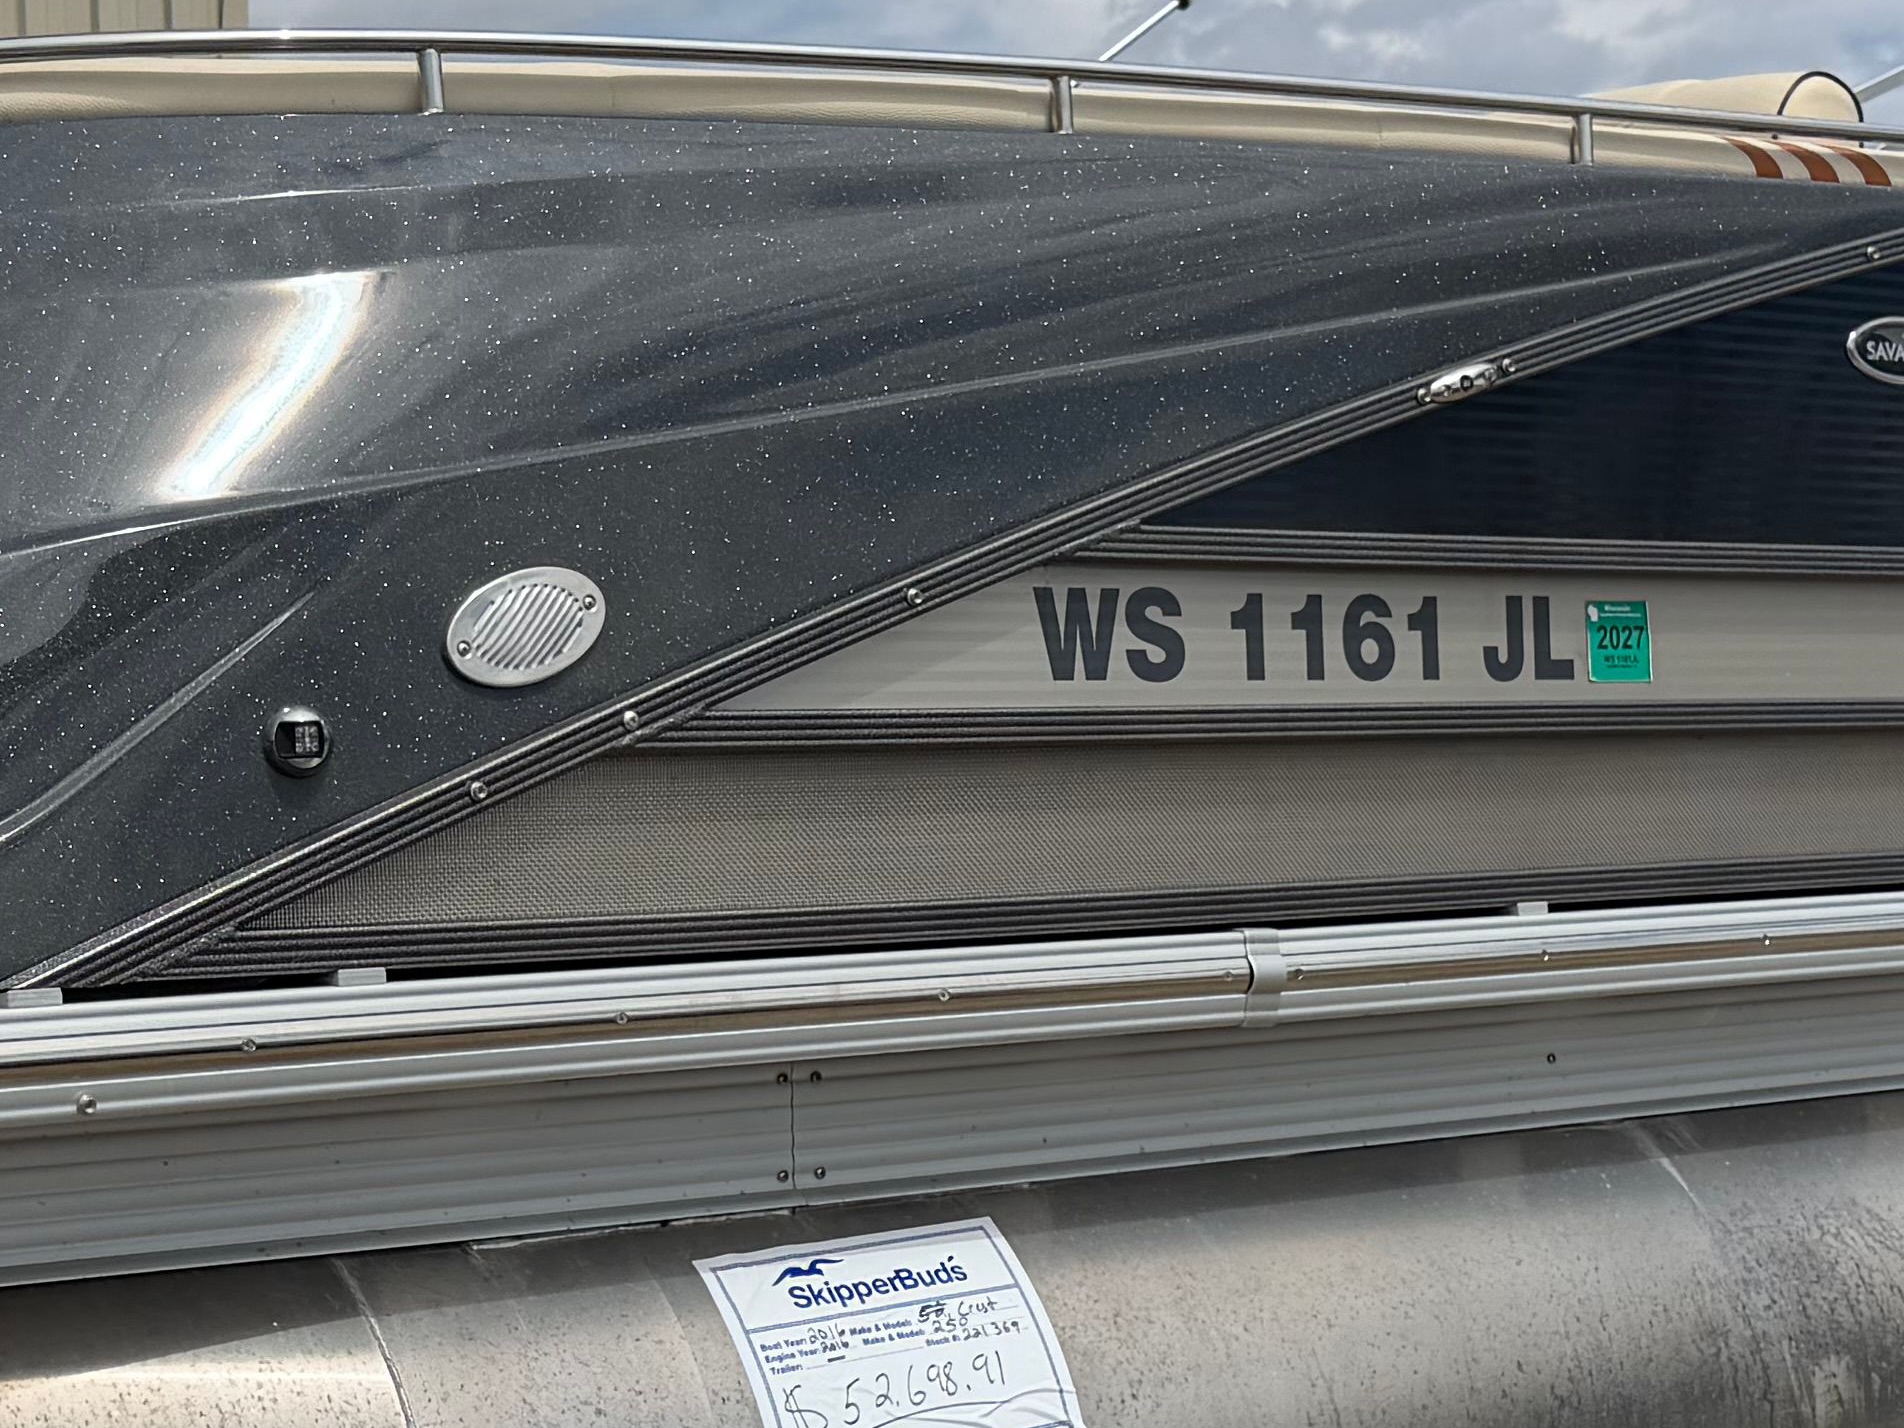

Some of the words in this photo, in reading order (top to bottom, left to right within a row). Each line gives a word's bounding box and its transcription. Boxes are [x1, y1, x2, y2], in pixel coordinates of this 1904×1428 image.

[1032, 586, 1186, 683] WS
[1230, 592, 1441, 683] 1161
[1482, 595, 1575, 683] JL
[1596, 625, 1645, 650] 2027
[788, 1256, 968, 1308] SkipperBud's
[760, 1341, 783, 1352] Boat
[807, 1323, 845, 1345] 2016
[849, 1326, 872, 1336] Make
[764, 1352, 796, 1363] Engine
[820, 1339, 849, 1353] 2016
[862, 1336, 886, 1346] Make
[932, 1315, 969, 1334] 250
[925, 1336, 950, 1347] Stock
